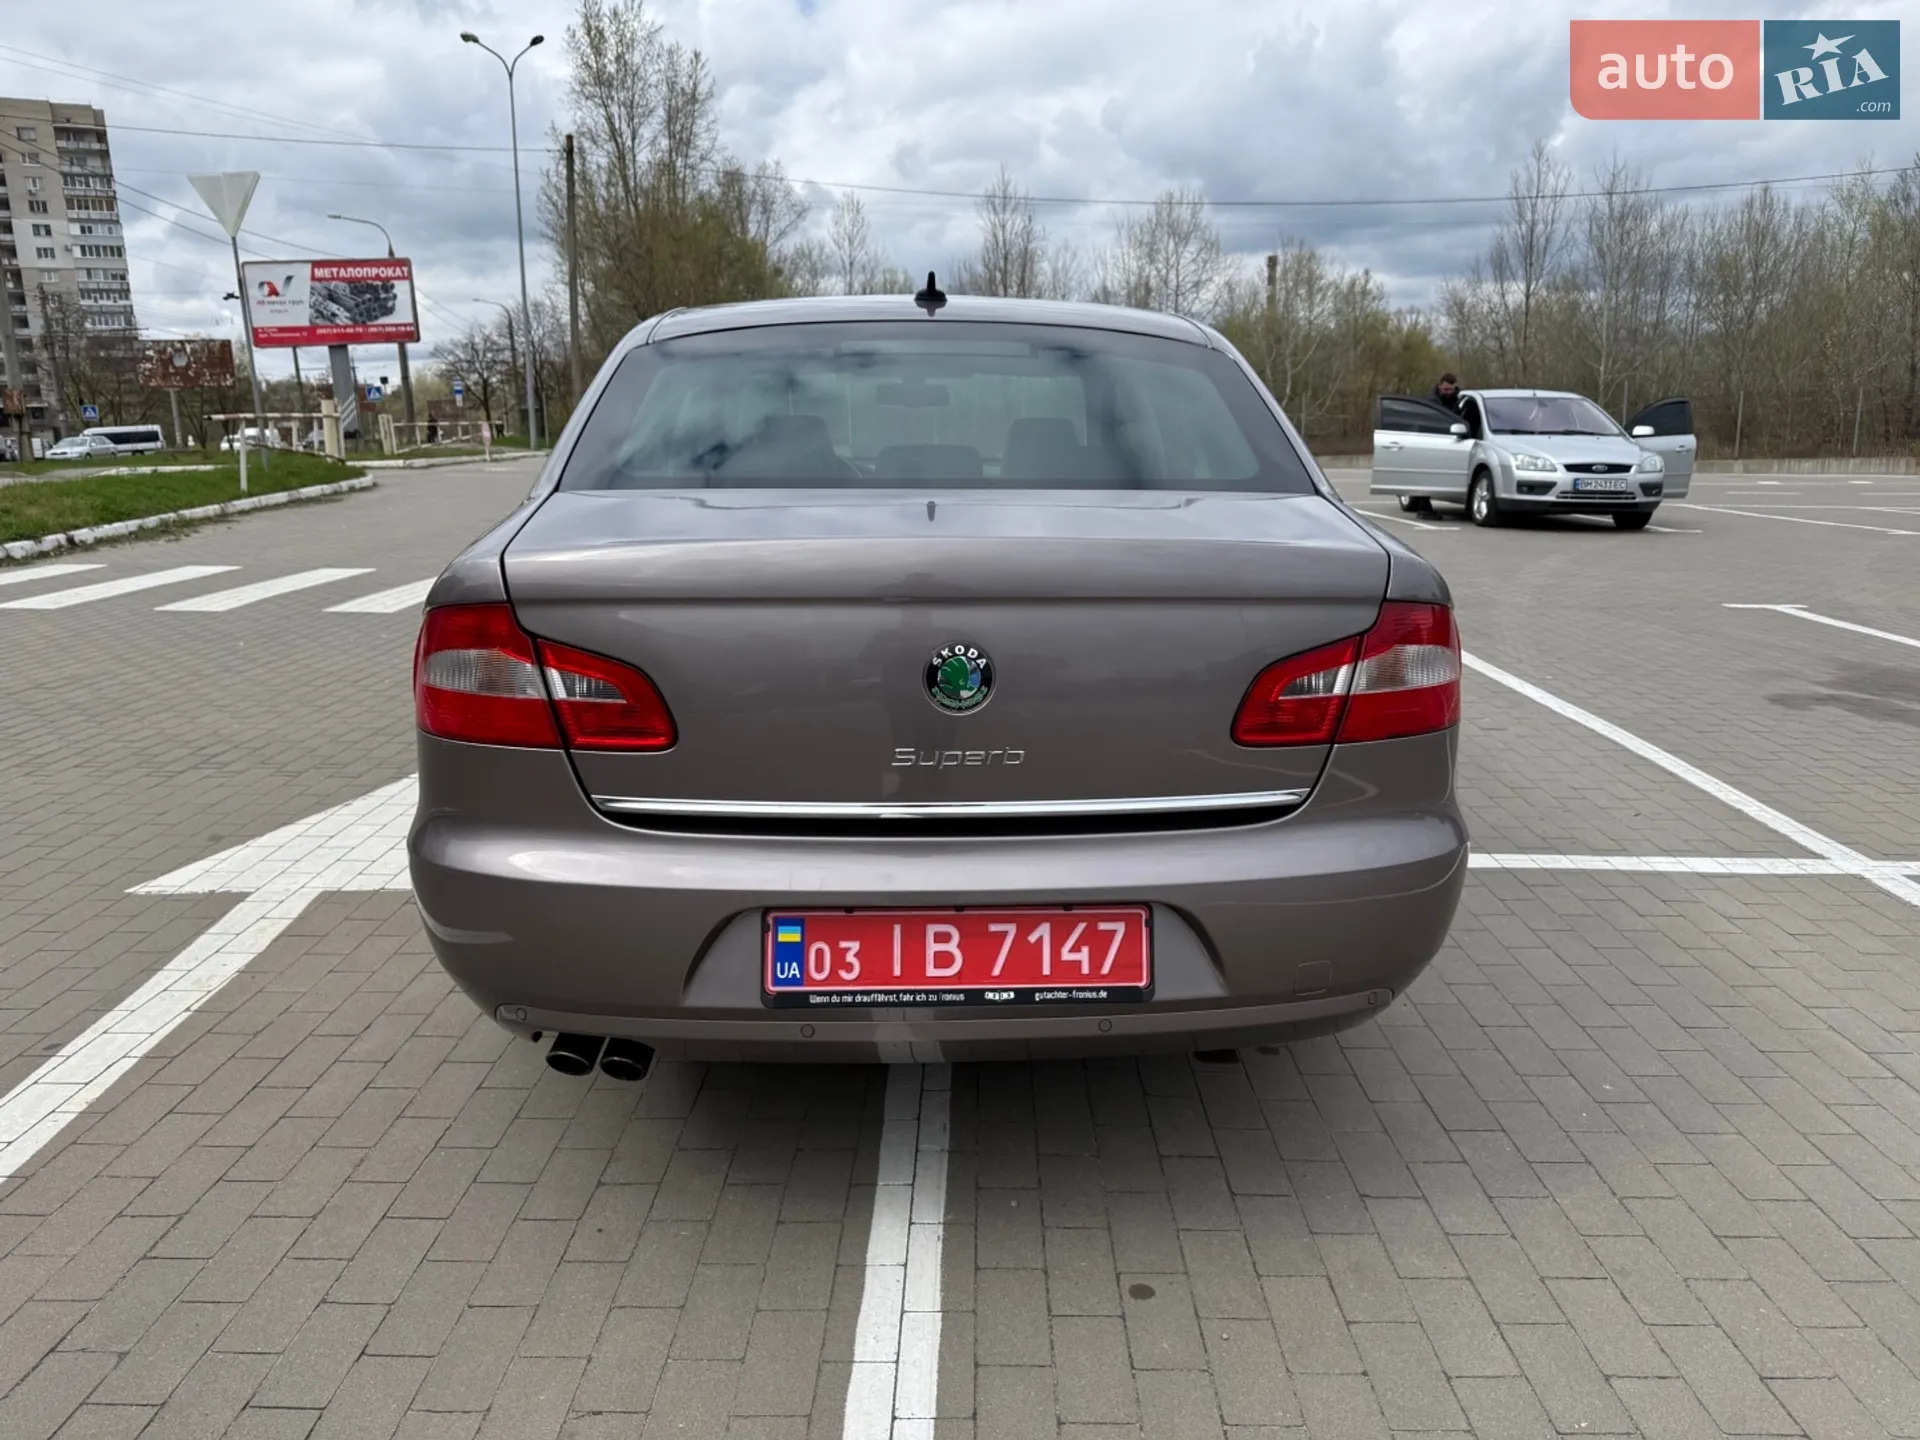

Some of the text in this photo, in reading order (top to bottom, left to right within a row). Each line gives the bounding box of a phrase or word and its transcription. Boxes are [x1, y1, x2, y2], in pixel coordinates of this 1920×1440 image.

[313, 266, 409, 279] МЕТАЛОПРОКАТ
[891, 746, 1026, 770] Superb
[776, 961, 801, 979] UA
[807, 940, 862, 981] 03
[987, 921, 1127, 977] 7147
[831, 994, 841, 1003] du
[842, 993, 853, 1003] mir
[899, 992, 914, 1002] fahr
[915, 992, 927, 1002] ich
[928, 993, 938, 1002] zu
